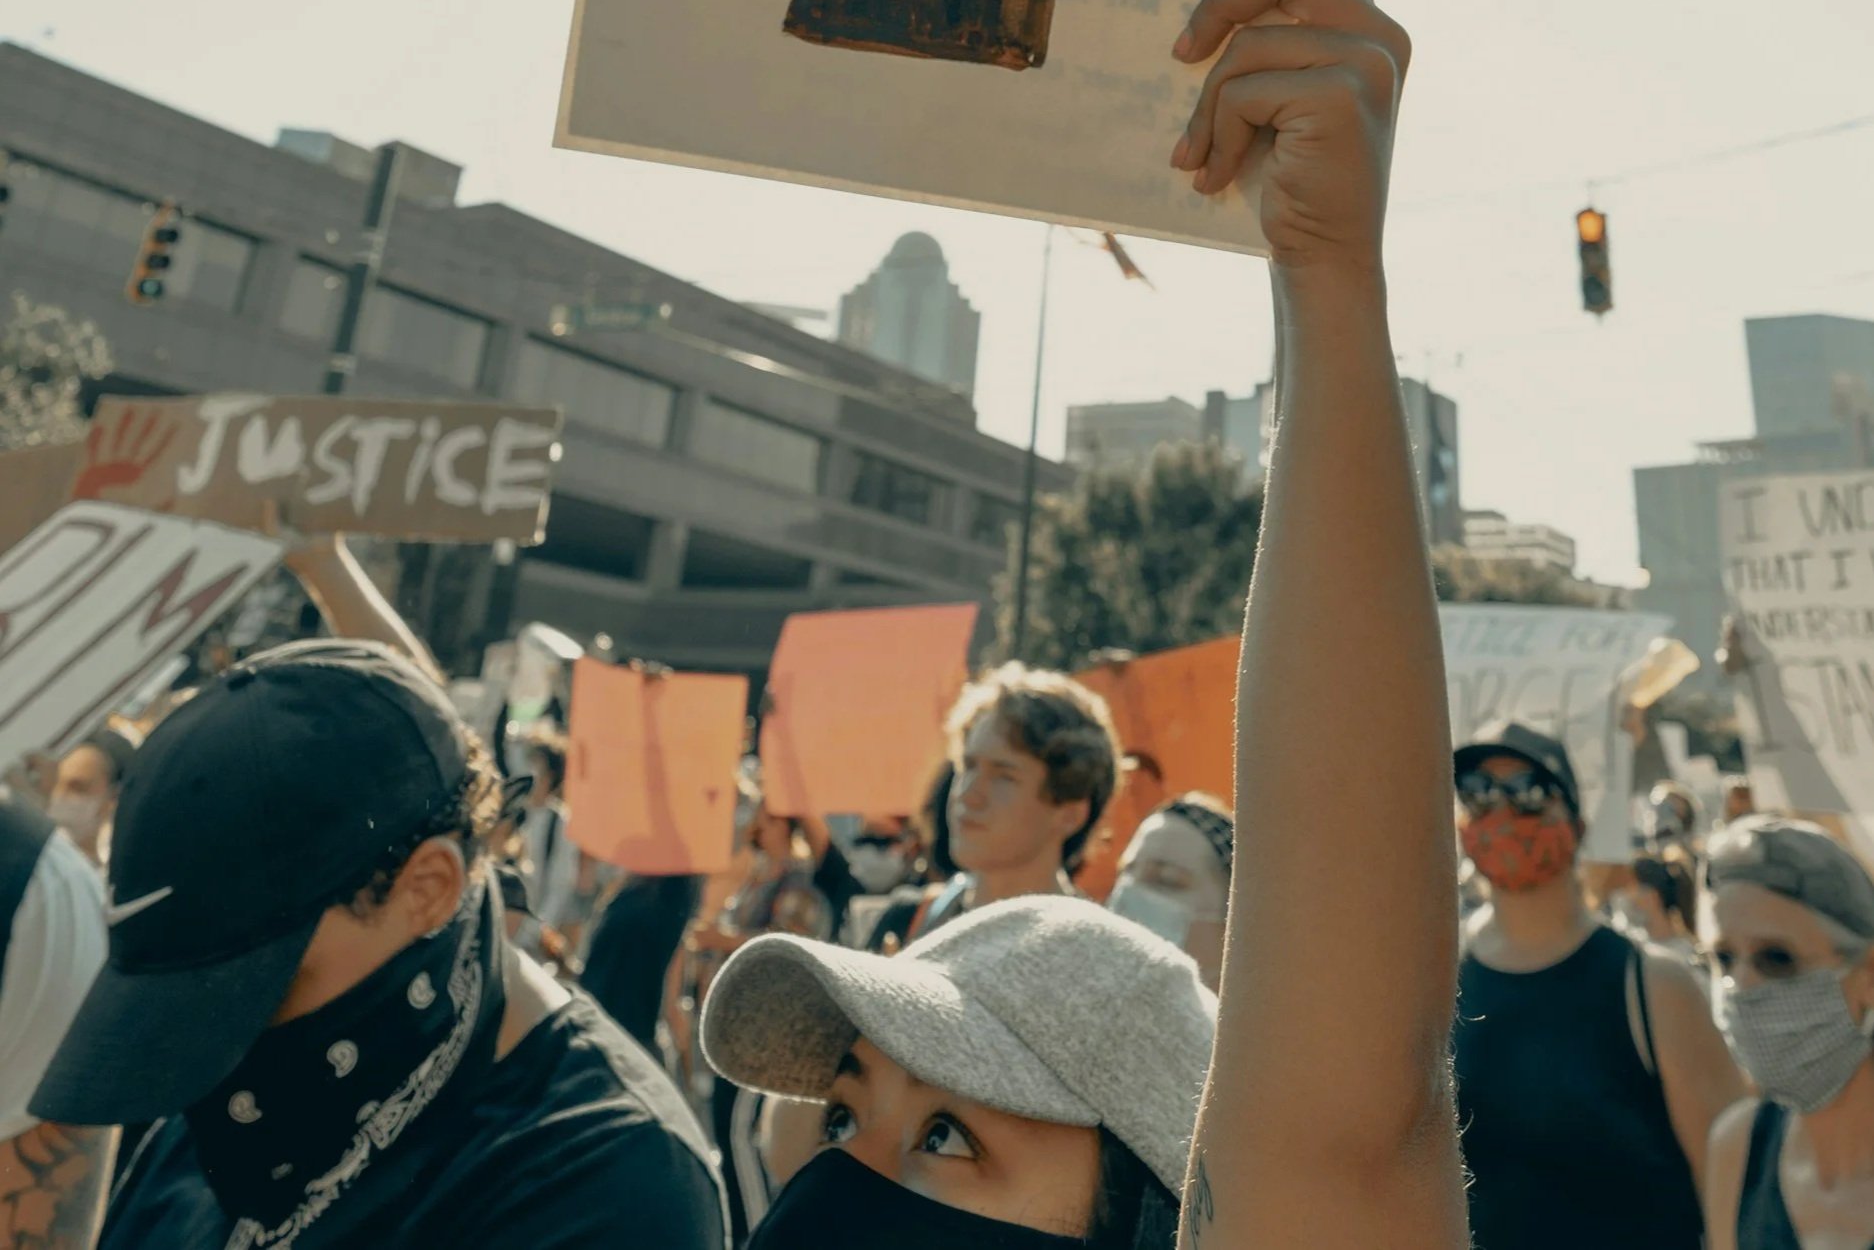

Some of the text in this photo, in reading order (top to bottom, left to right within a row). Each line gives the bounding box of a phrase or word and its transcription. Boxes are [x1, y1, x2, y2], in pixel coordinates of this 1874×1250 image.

[1733, 485, 1769, 544] I
[1726, 548, 1816, 594] THAT
[1829, 546, 1856, 591] I
